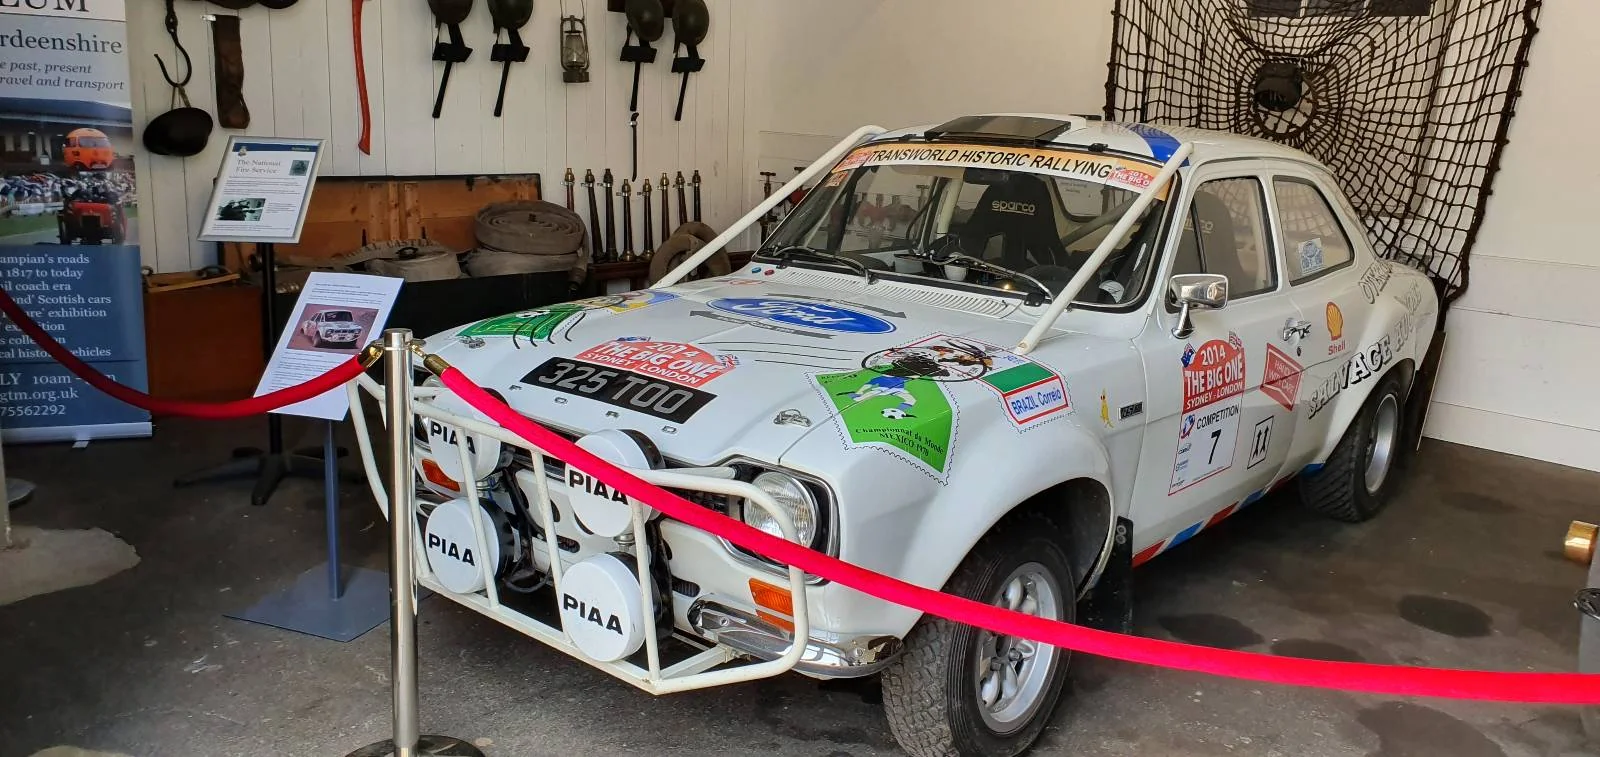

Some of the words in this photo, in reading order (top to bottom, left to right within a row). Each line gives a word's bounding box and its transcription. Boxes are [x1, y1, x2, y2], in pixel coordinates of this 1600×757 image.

[10, 61, 41, 73] past,
[45, 63, 92, 74] present
[36, 77, 60, 87] and
[64, 78, 125, 92] transport
[868, 149, 958, 162] TRANSWORLD
[957, 150, 1030, 166] HISTORIC
[1030, 155, 1112, 178] RALLYING
[1113, 170, 1128, 179] THE
[1128, 171, 1149, 179] 2014
[992, 200, 1036, 213] sparco
[57, 254, 90, 264] roads
[7, 267, 33, 279] 1817
[36, 268, 48, 278] to
[51, 267, 84, 279] today
[15, 281, 50, 291] coach
[38, 295, 85, 304] Scottish
[88, 296, 112, 304] cars
[48, 308, 107, 317] exhibition
[733, 301, 856, 324] Ford
[594, 341, 634, 358] THE
[630, 349, 668, 365] BIG
[667, 359, 724, 377] ONE
[646, 343, 697, 358] 2014
[1201, 344, 1226, 366] 2014
[1328, 342, 1346, 356] Shell
[538, 362, 617, 396] 325
[583, 352, 634, 366] SYDNEY
[639, 362, 701, 384] LONDON
[1184, 370, 1205, 397] THE
[1206, 365, 1223, 391] BIG
[1224, 355, 1243, 382] ONE
[1307, 335, 1393, 420] SALVAGE
[34, 375, 72, 385] 10am
[1011, 394, 1038, 415] BRAZIL
[1038, 387, 1062, 406] Correio
[1186, 391, 1213, 410] SYDNEY
[1216, 381, 1243, 399] LONDON
[1196, 403, 1239, 430] COMPETITION
[880, 432, 914, 448] MEXICO
[1208, 429, 1222, 465] 7
[569, 469, 629, 506] PIAA
[428, 532, 476, 567] PIAA
[563, 593, 624, 636] PIAA
